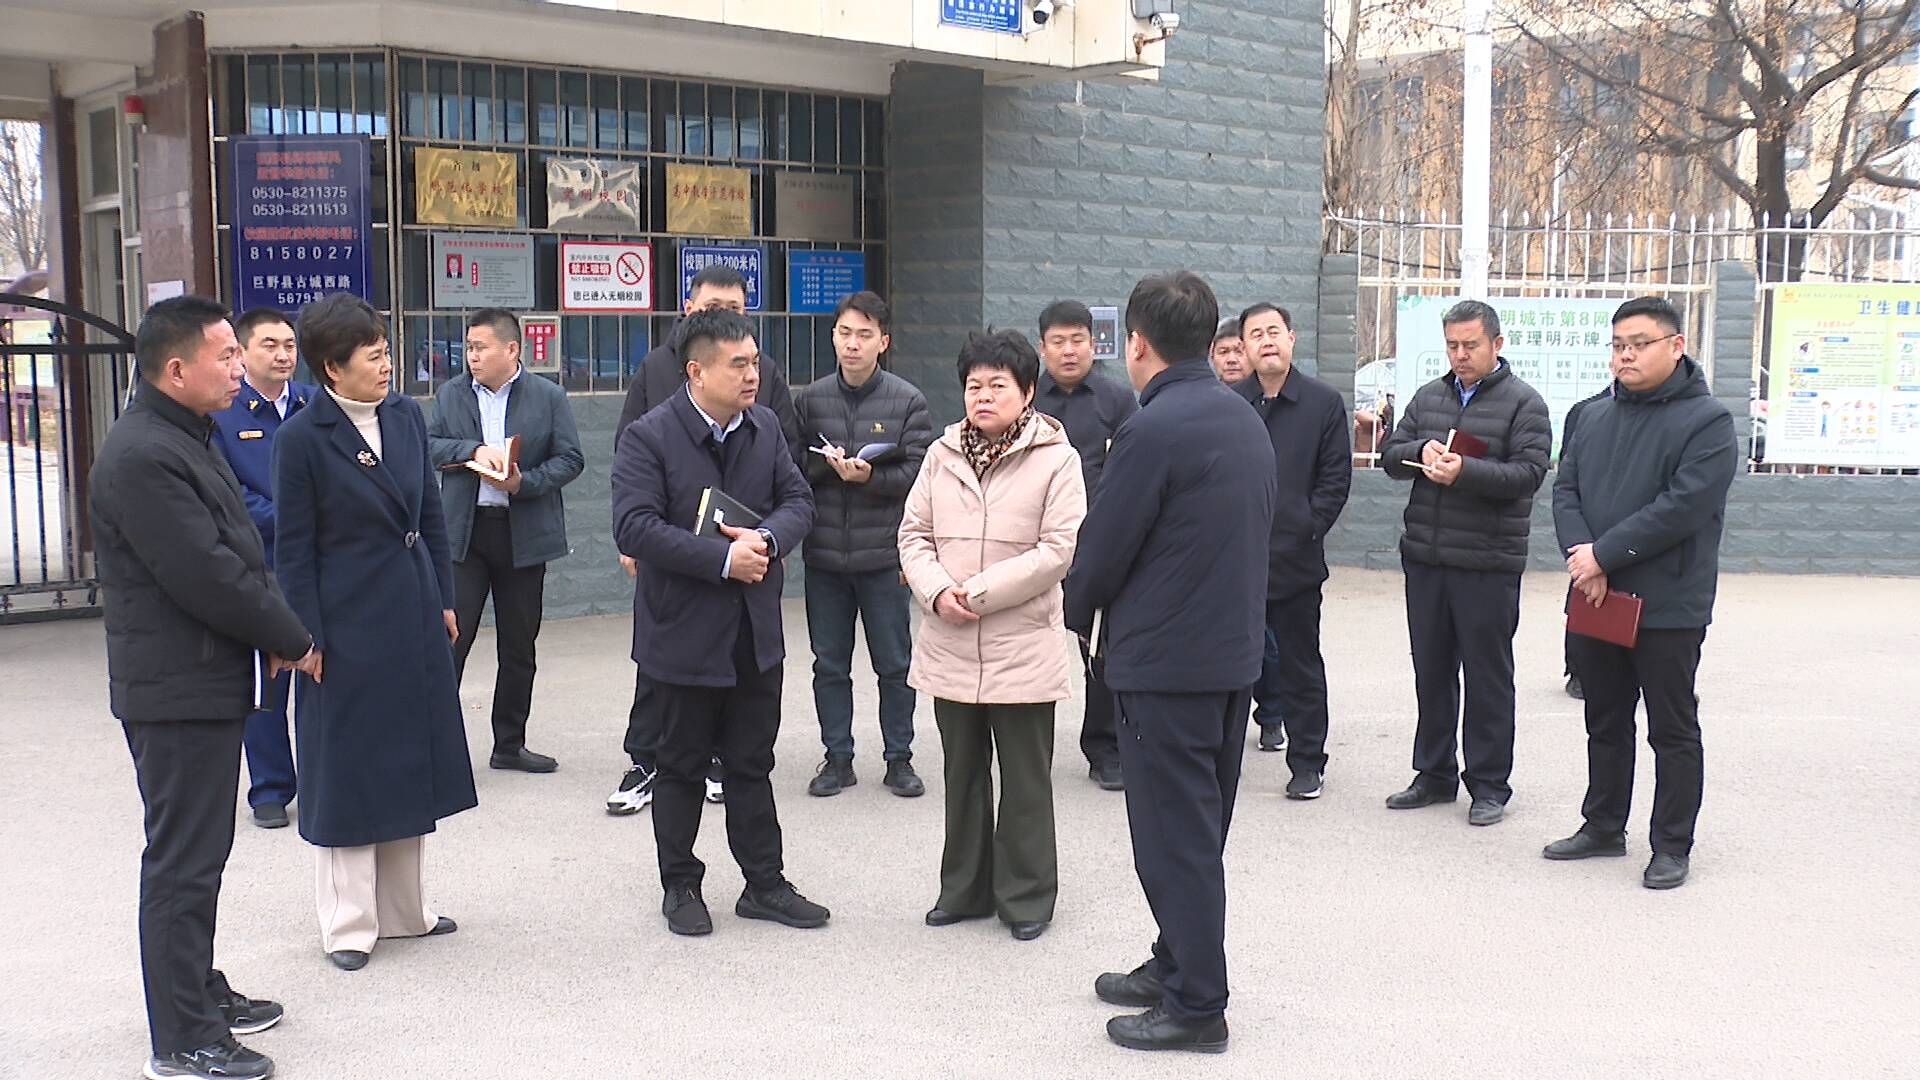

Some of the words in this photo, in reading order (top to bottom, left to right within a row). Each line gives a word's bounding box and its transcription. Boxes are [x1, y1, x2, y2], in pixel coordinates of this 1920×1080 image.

[252, 186, 347, 199] 0530-8211375
[252, 203, 348, 216] 0530-8211513
[250, 246, 353, 260] 8158027
[571, 263, 610, 274] 禁止吸烟
[685, 252, 757, 273] 校园周边200米内
[253, 275, 351, 290] 巨野县古城西路
[573, 290, 643, 302] 您已进入无烟校园
[1508, 329, 1601, 347] 管理明示牌
